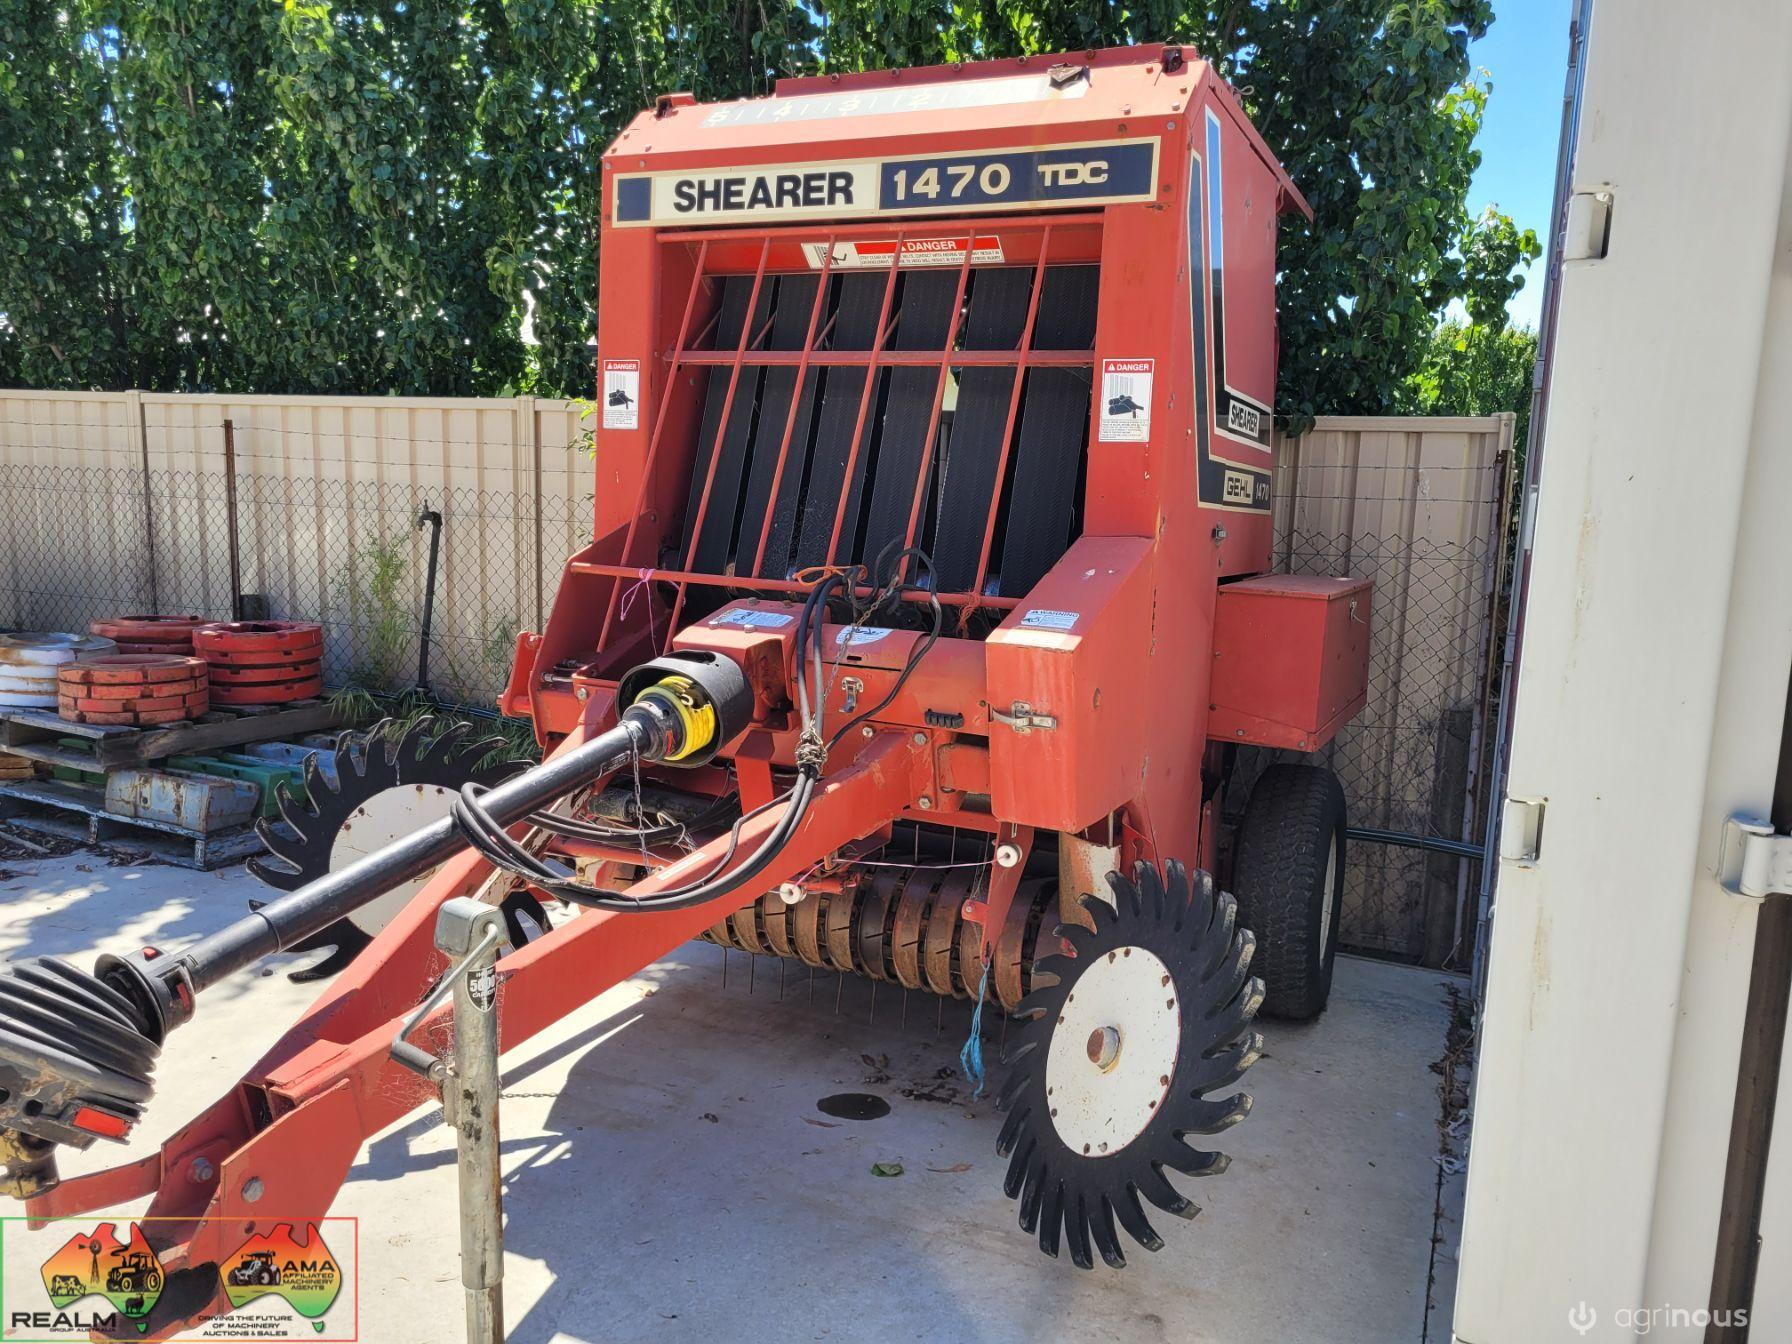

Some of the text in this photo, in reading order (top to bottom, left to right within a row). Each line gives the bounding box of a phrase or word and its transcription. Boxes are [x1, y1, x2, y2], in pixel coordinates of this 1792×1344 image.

[673, 171, 854, 213] SHEARER
[893, 160, 1109, 201] 1470 TDC
[907, 241, 957, 252] DANGER
[1116, 363, 1149, 371] DANGER
[1231, 404, 1258, 433] SHEARER
[1227, 477, 1270, 501] GEHL 1470
[1041, 610, 1079, 618] WARNING
